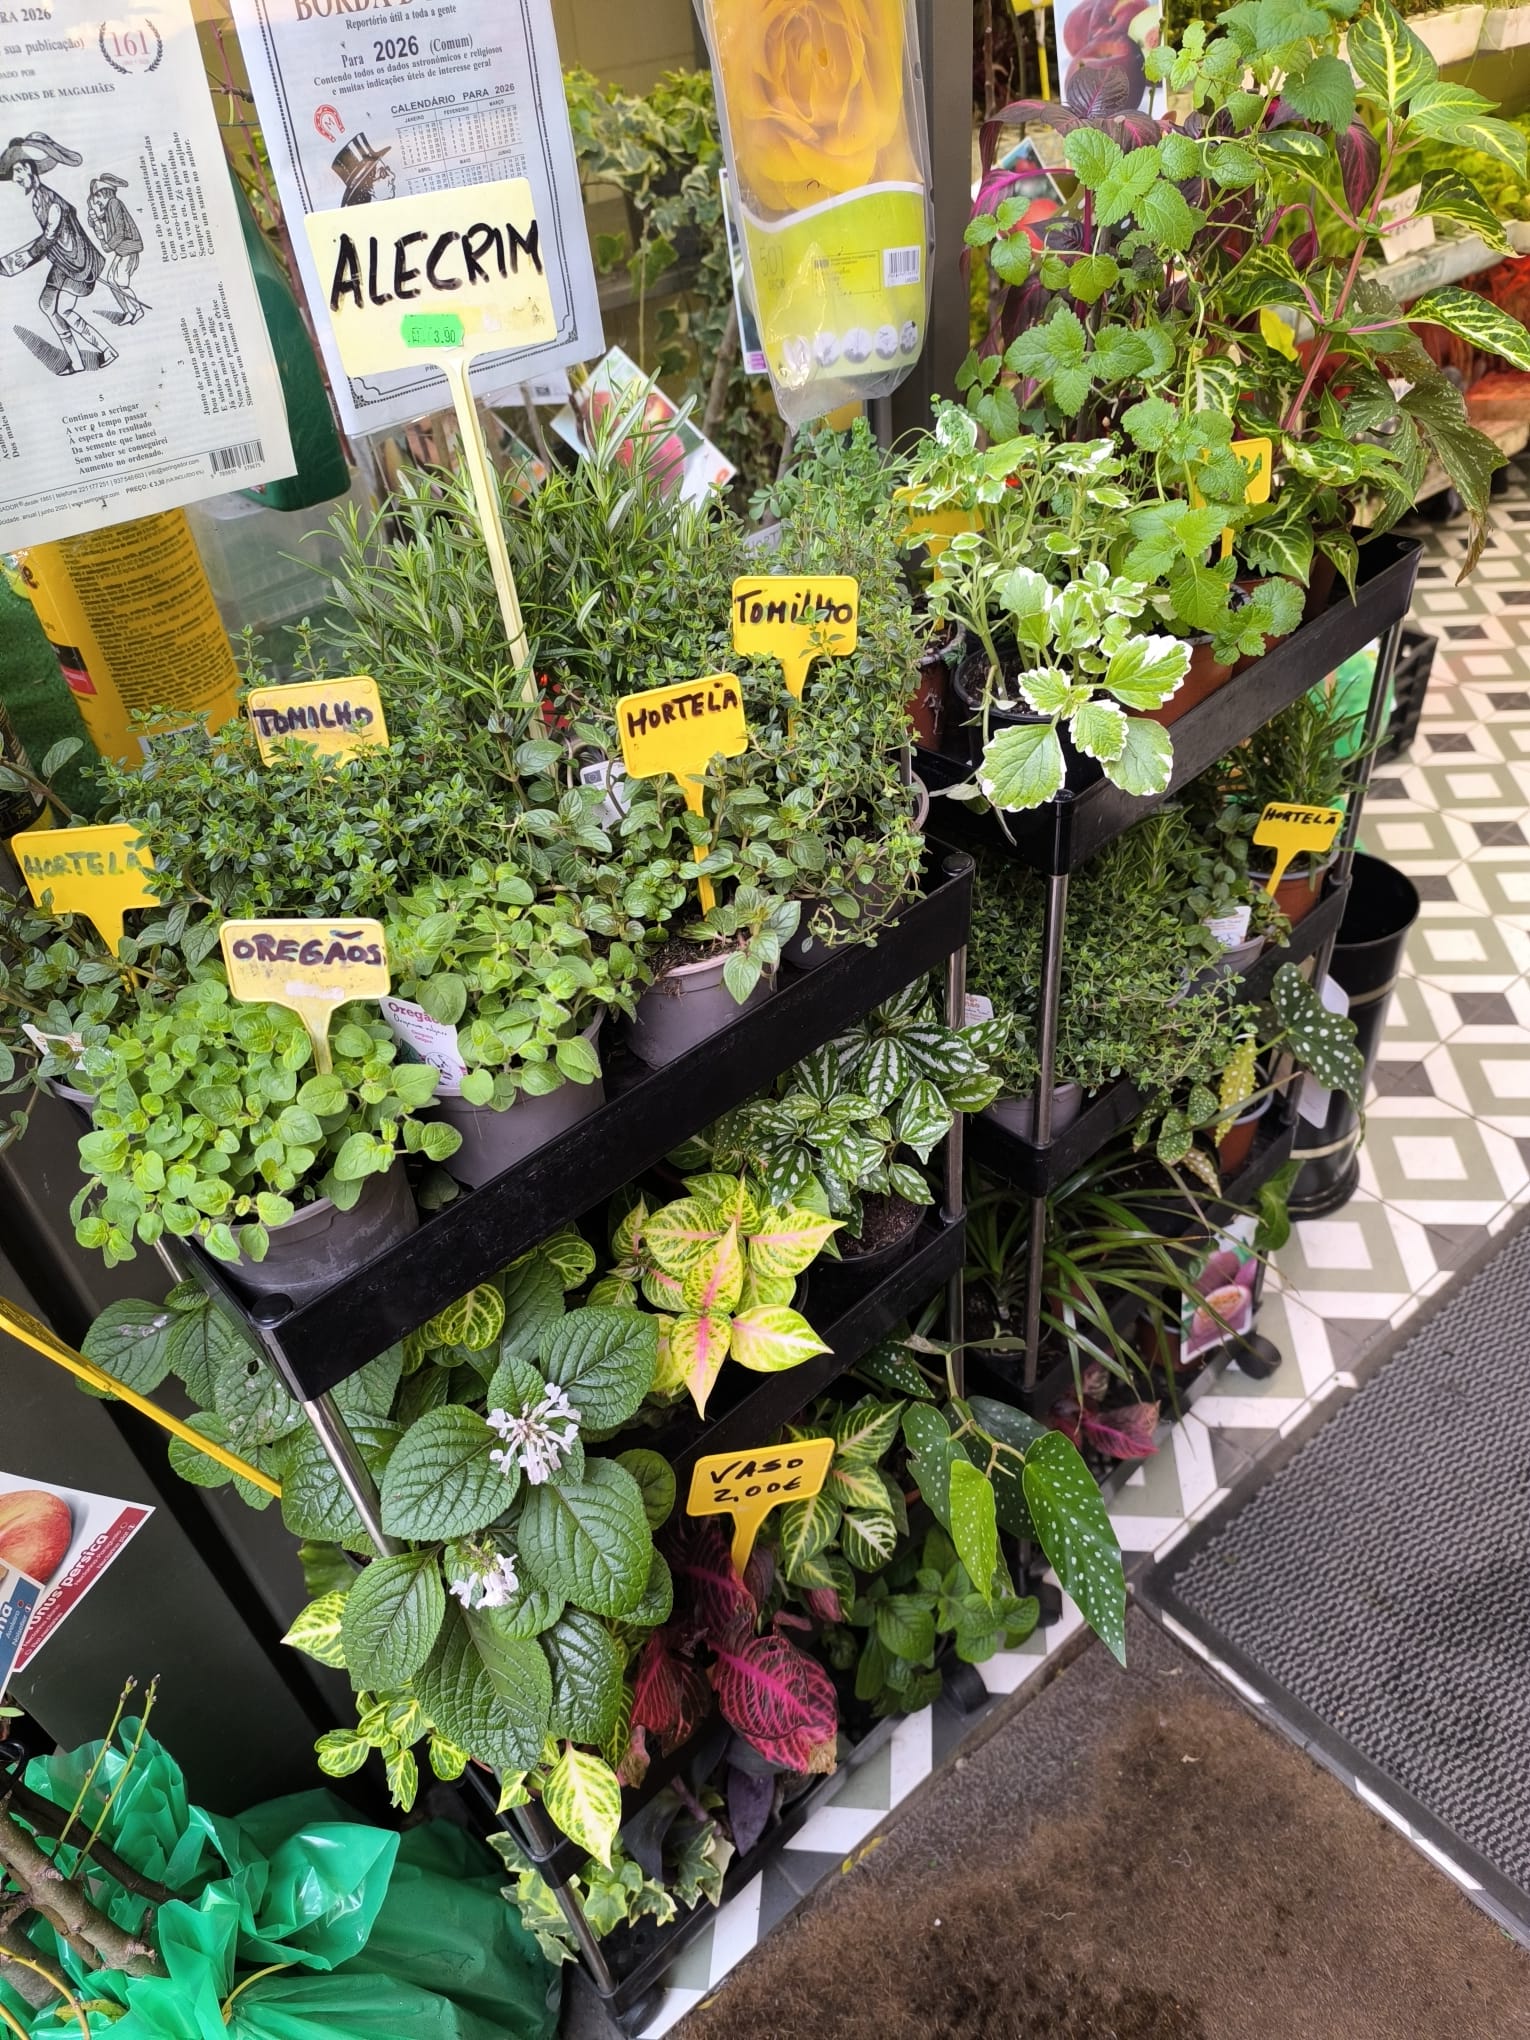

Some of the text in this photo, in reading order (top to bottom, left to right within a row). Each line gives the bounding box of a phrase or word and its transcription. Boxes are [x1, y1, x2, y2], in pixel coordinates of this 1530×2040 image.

[20, 6, 51, 22] 2026
[345, 4, 456, 31] Reportório útil a toda a gente
[3, 34, 85, 55] sua publicação)
[107, 29, 150, 58] 161
[340, 33, 473, 68] Para 2026 (Comum)
[313, 71, 352, 86] Contendo
[353, 67, 374, 79] todos
[376, 66, 385, 74] os
[386, 61, 410, 72] dados
[411, 53, 461, 68] astronómicos
[470, 46, 503, 58] religiosos
[331, 57, 492, 96] e muitas indicações úteis de interesse geral
[390, 83, 515, 114] CALENDÁRIO PARA 2026
[167, 149, 183, 186] povinho
[144, 135, 178, 261] Com as chamadas arruadas
[172, 131, 206, 257] Sempre armado em anjinho
[184, 138, 215, 255] Como um santo no andor.
[139, 155, 170, 263] Ruas tão movimentadas
[160, 162, 188, 260] Um arco-íris multicor
[183, 220, 192, 237] vou
[186, 239, 195, 248] lá
[188, 250, 197, 258] E
[330, 220, 542, 312] ALECRIM
[433, 328, 456, 344] 3.90
[61, 411, 98, 424] Continuo
[108, 403, 139, 415] seringar
[73, 424, 87, 432] ver
[97, 417, 122, 428] tempo
[123, 411, 147, 424] passar
[220, 404, 228, 412] E
[71, 429, 157, 455] Da semente que lancei
[77, 432, 104, 443] espera
[105, 428, 116, 437] do
[118, 420, 152, 434] resultado
[74, 456, 92, 465] Sem
[93, 451, 115, 460] saber
[127, 436, 168, 453] conseguirei
[79, 449, 164, 475] Aumento no ordenado.
[253, 701, 373, 737] TOMILHO
[627, 682, 738, 738] HORTELÃ
[232, 929, 382, 966] OREGÃOS
[710, 1458, 804, 1484] VASO
[62, 1533, 109, 1587] persica
